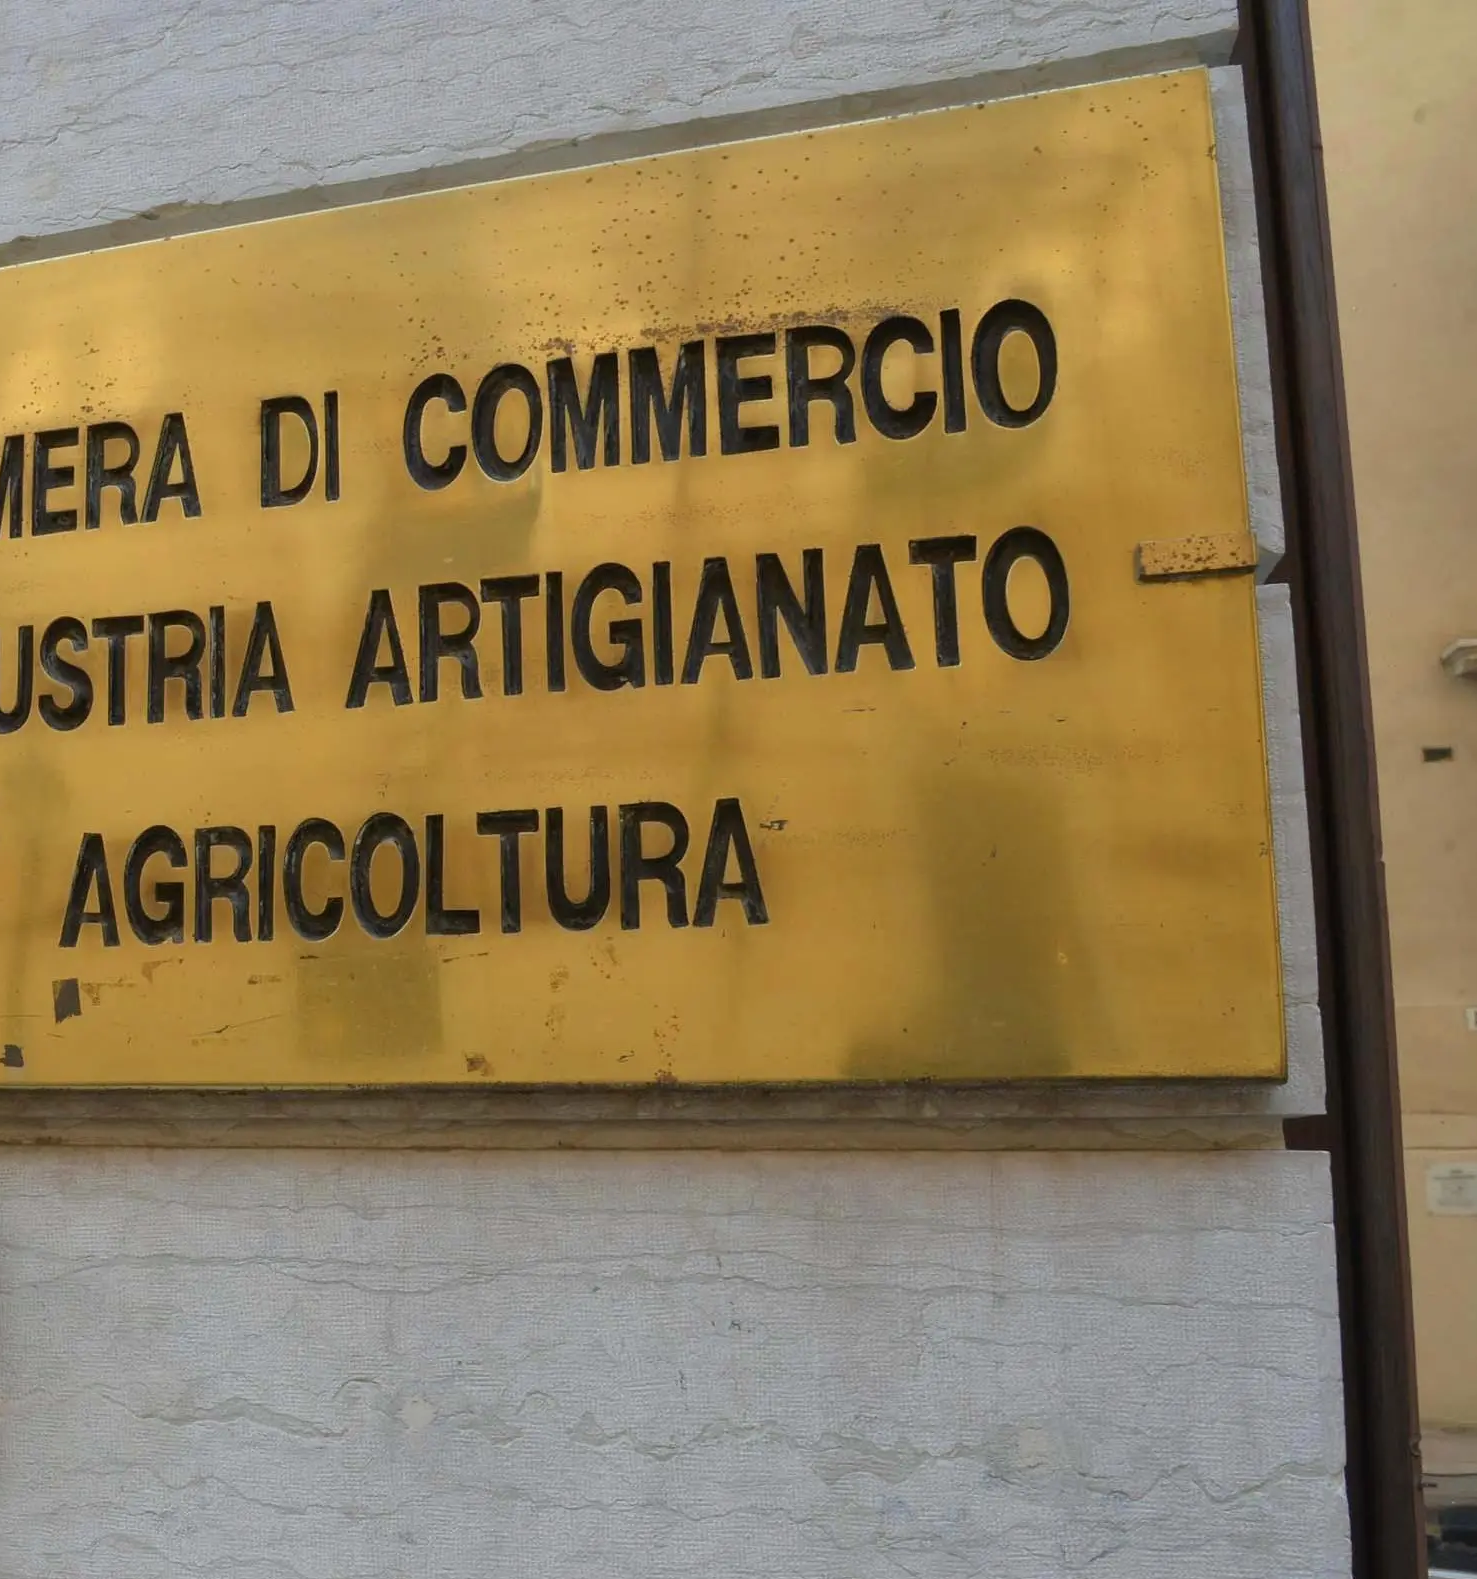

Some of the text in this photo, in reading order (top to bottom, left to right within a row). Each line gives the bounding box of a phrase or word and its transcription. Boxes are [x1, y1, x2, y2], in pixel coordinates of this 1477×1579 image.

[260, 390, 340, 508] DI
[402, 298, 1058, 491] COMMERCIO
[345, 526, 1070, 709] ARTIGIANATO
[58, 797, 771, 948] AGRICOLTURA
